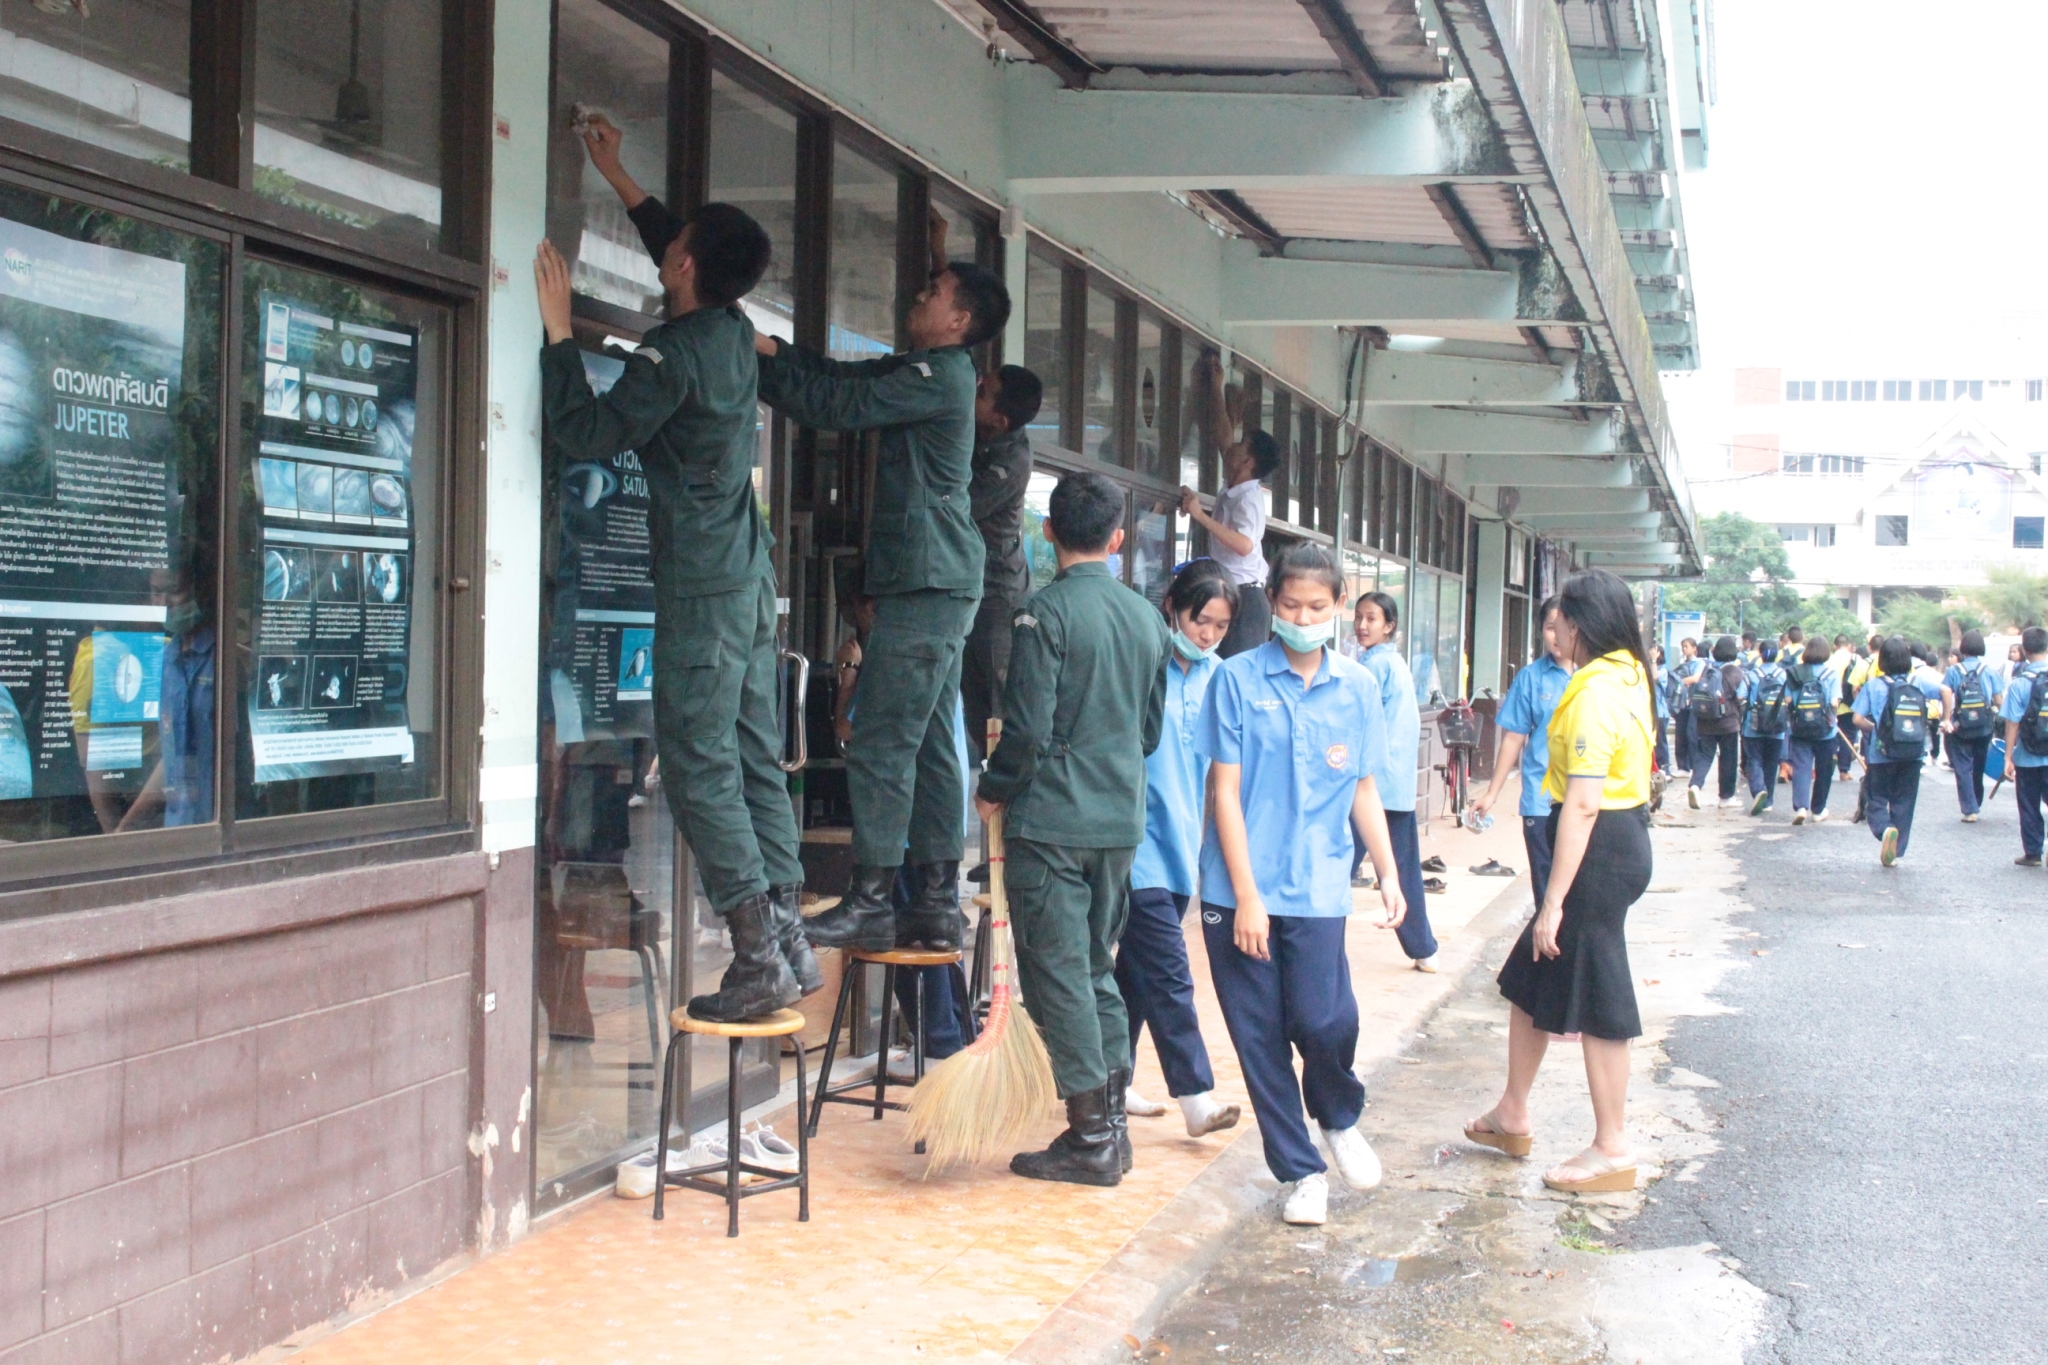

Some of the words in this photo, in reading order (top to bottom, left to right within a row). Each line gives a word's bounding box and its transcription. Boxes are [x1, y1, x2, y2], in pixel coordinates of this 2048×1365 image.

[4, 257, 33, 276] NARIT
[53, 367, 169, 408] ดาวพฤหัสบดี
[54, 403, 131, 440] JUPETER
